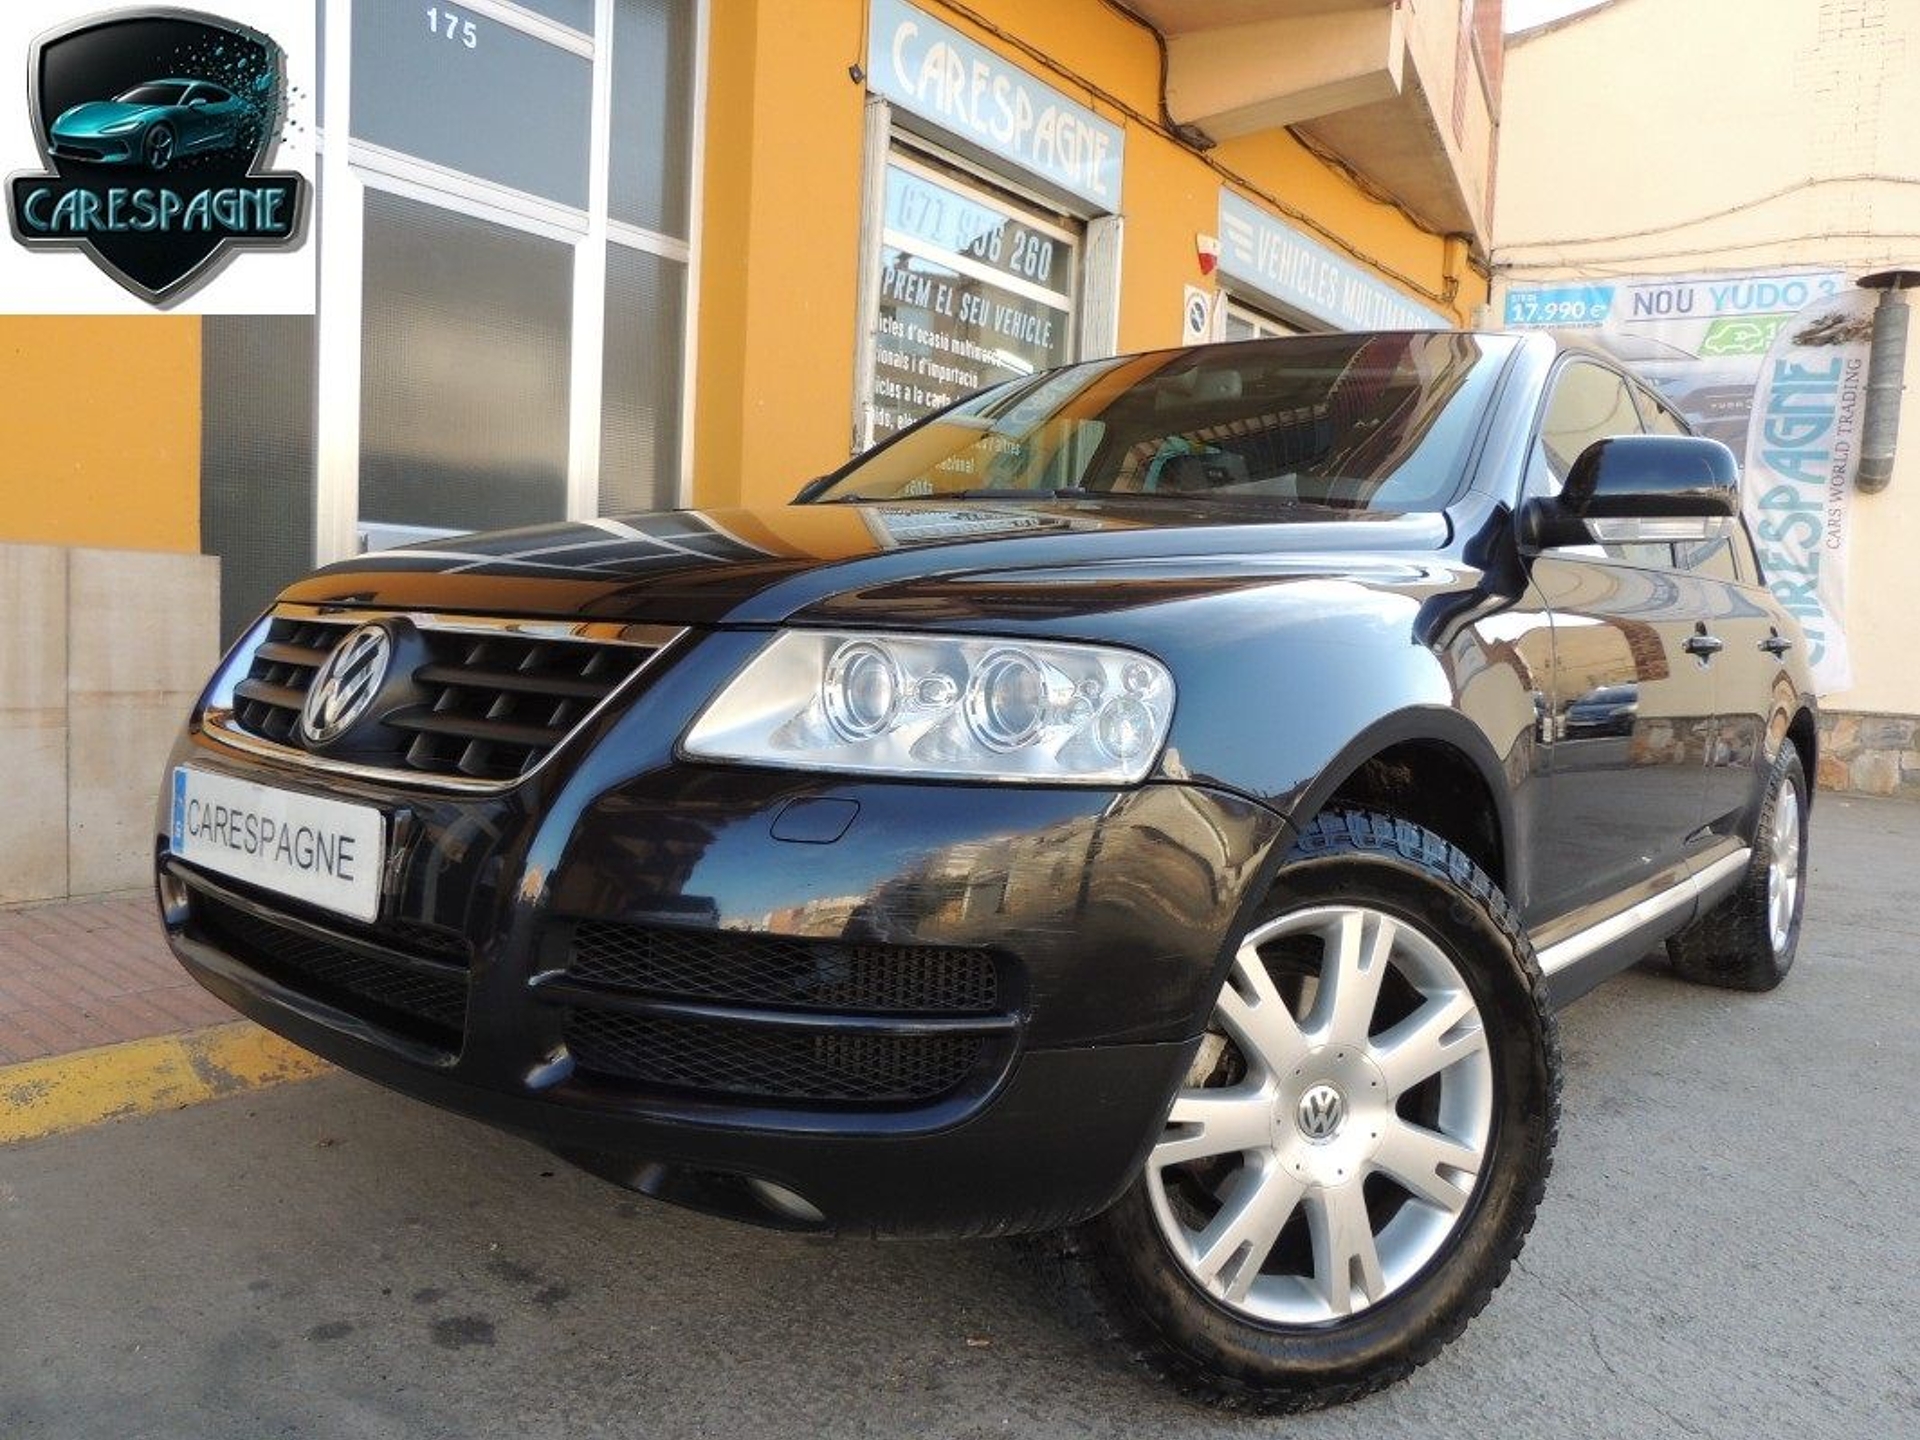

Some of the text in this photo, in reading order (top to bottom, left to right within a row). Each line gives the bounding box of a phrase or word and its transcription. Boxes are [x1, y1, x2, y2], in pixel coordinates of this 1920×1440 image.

[425, 8, 478, 49] 175
[892, 21, 1110, 195] CARESPAGNE
[1010, 230, 1053, 281] 260
[1257, 226, 1339, 311] VEHICLES
[935, 286, 954, 318] EL
[960, 293, 988, 328] SEU
[1512, 301, 1586, 322] 17.990
[1633, 288, 1694, 316] NOU
[1709, 281, 1809, 312] YUDO
[913, 385, 923, 404] la
[1825, 358, 1862, 550] CARS WORLD TRADING
[1758, 357, 1843, 667] RESPAGNE
[187, 798, 356, 882] CARESPAGNE
